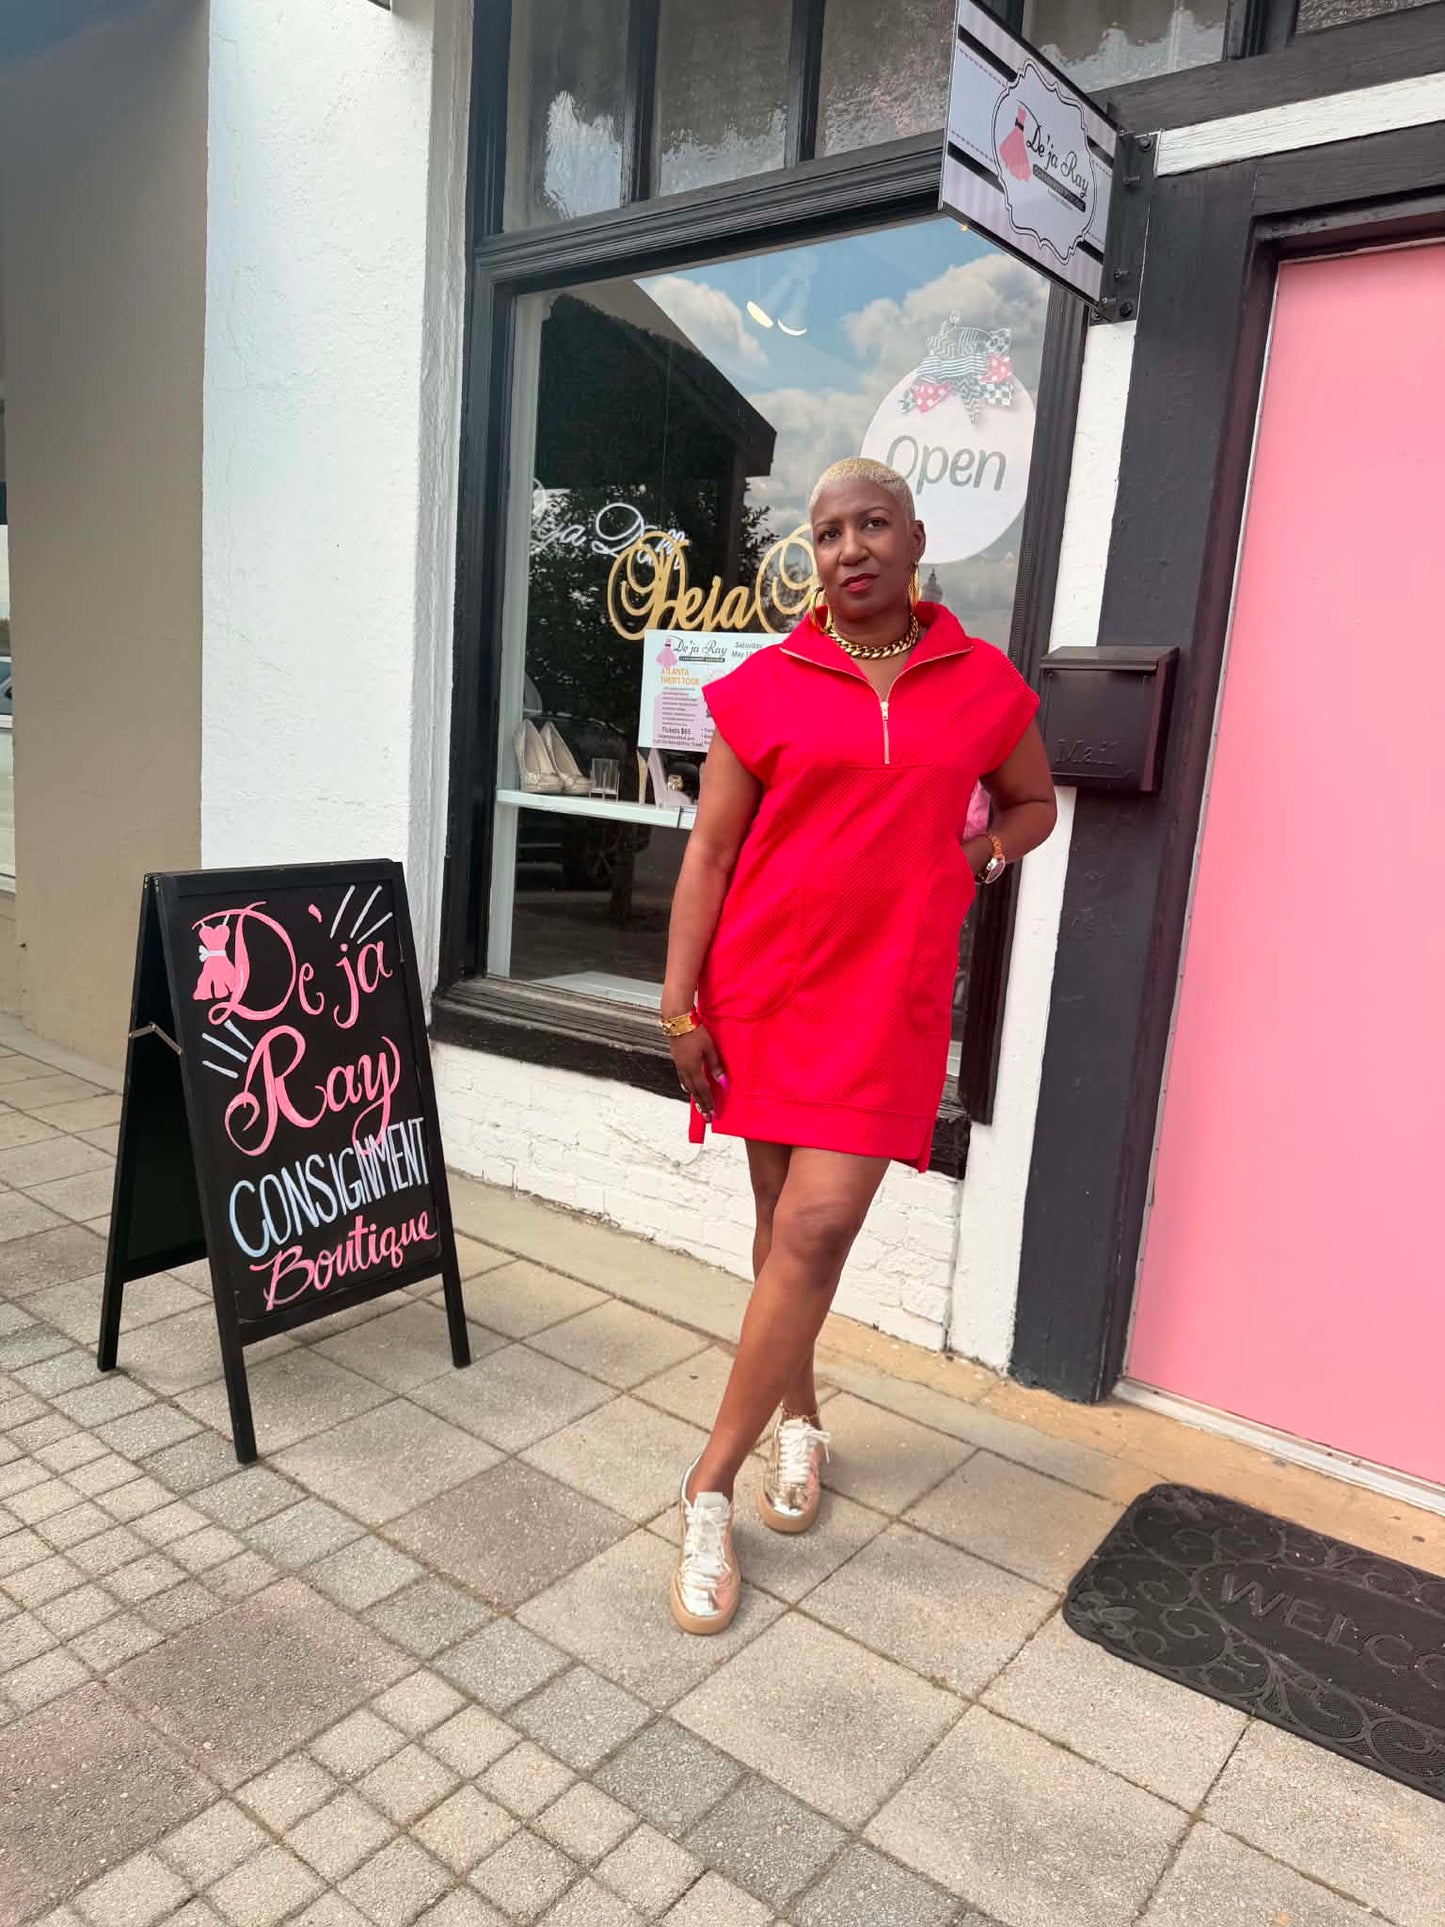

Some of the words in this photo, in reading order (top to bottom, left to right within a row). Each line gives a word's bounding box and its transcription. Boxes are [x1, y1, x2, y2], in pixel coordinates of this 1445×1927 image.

[1061, 149, 1089, 198] Ray
[885, 434, 1007, 495] Open
[661, 667, 689, 676] ATLANTA
[705, 639, 728, 656] Ray
[661, 726, 680, 734] Tickets
[224, 1025, 400, 1157] Ray
[228, 1117, 430, 1258] CONSIGNMENT
[249, 1209, 438, 1312] Boutique
